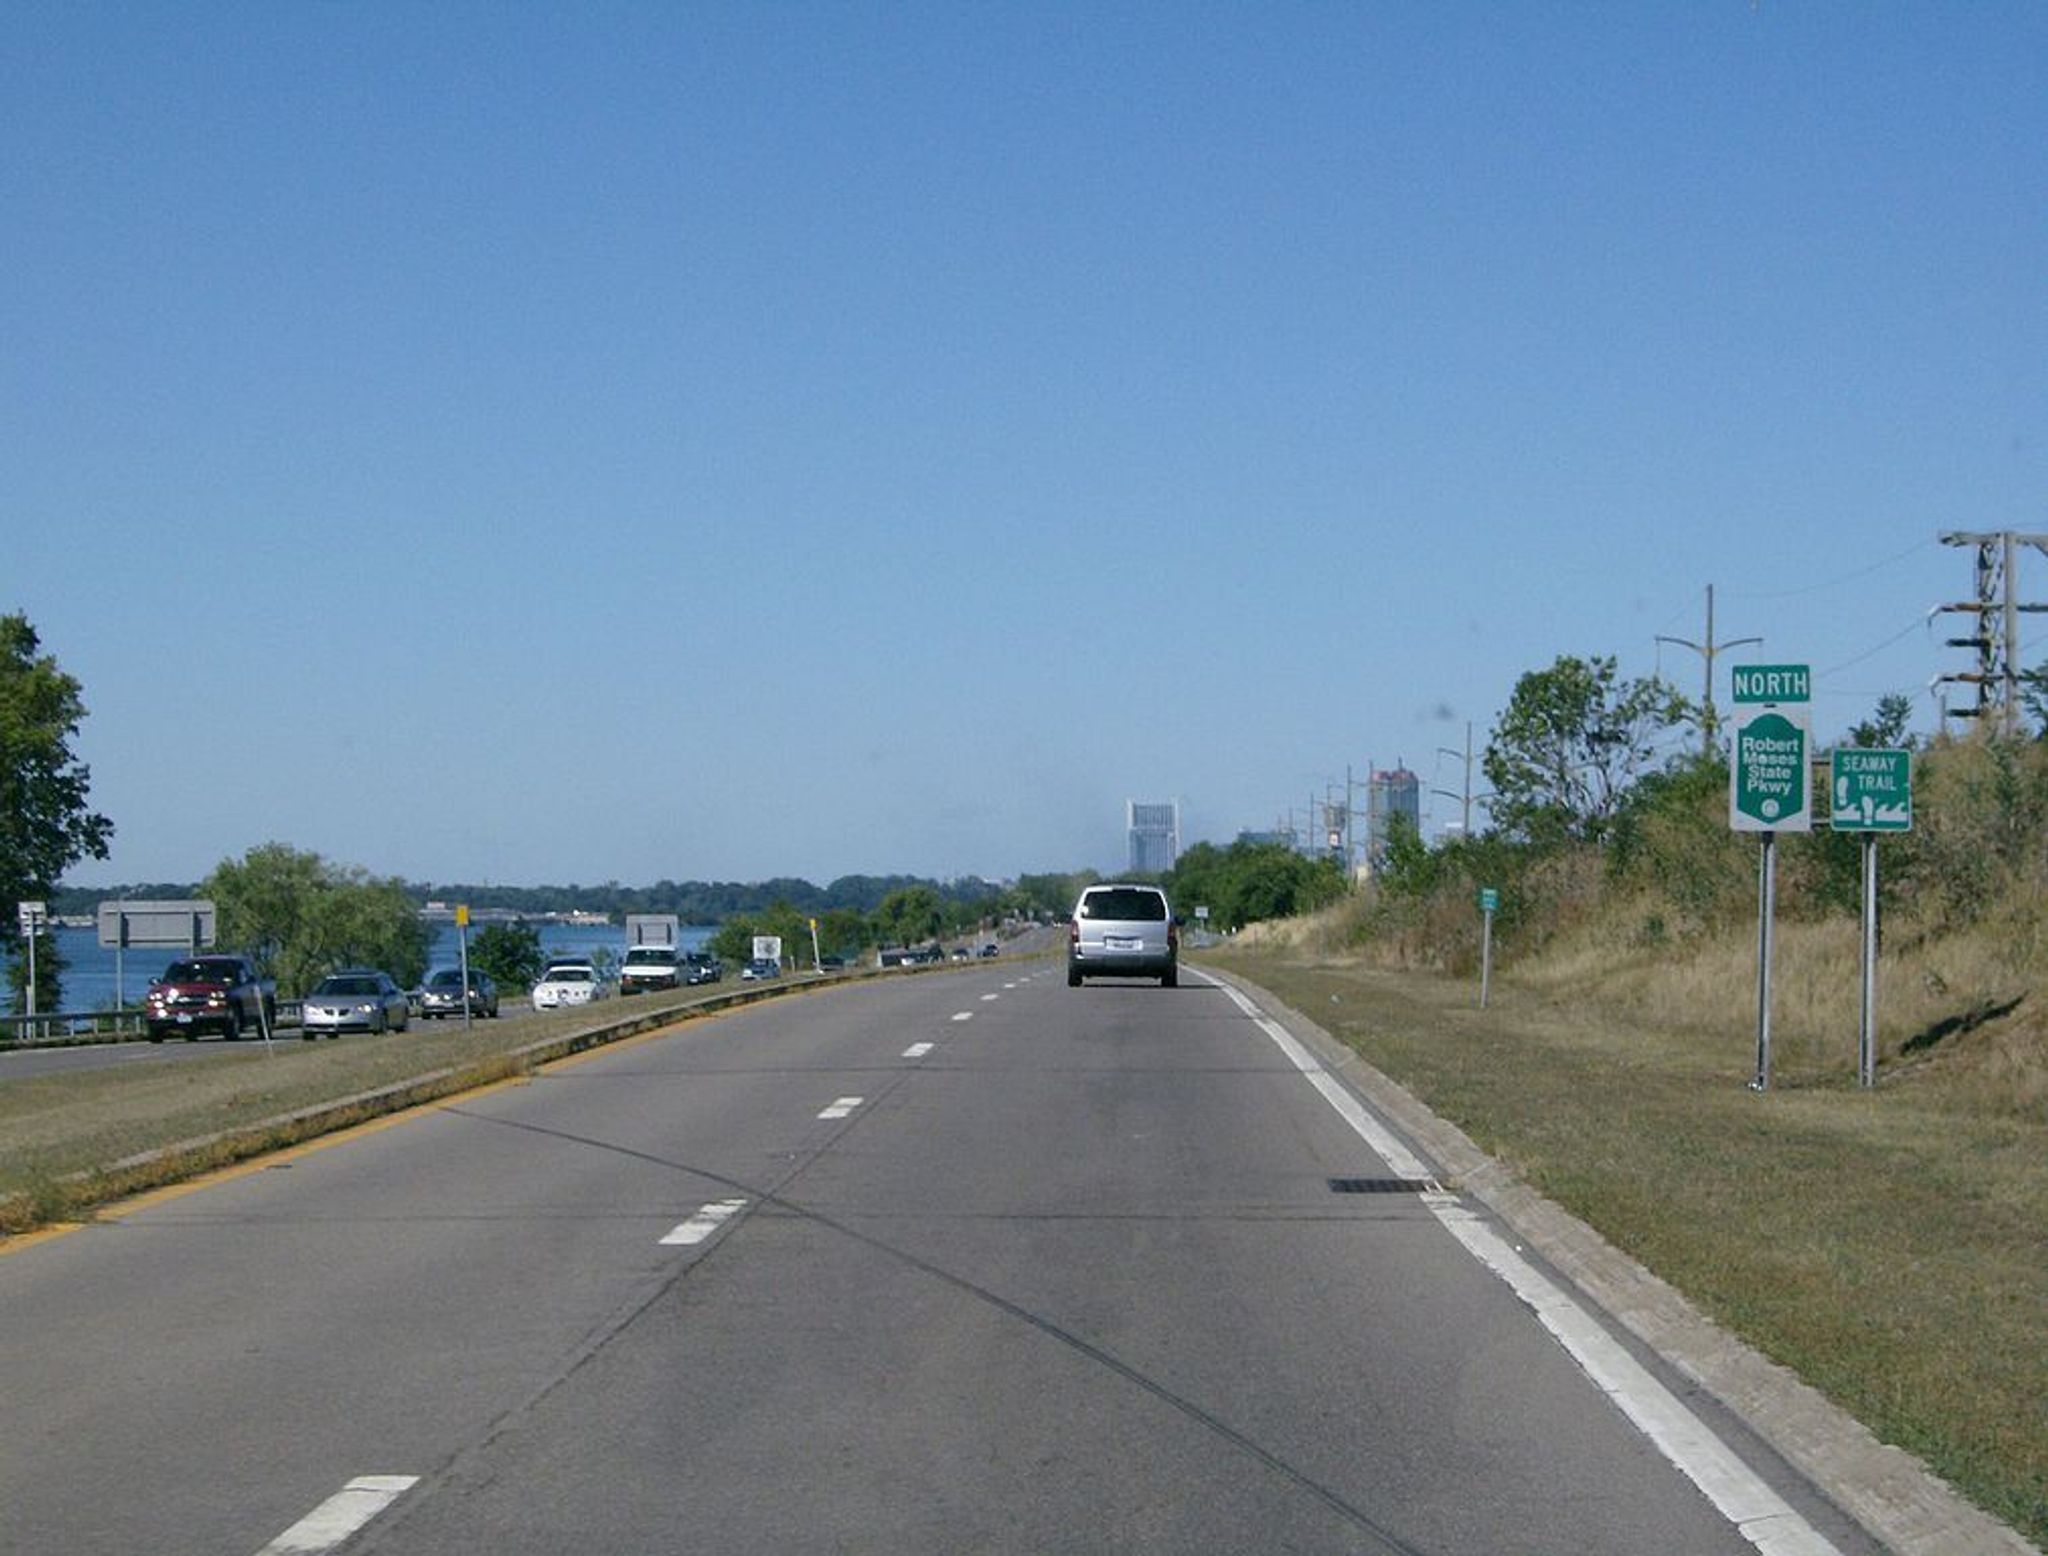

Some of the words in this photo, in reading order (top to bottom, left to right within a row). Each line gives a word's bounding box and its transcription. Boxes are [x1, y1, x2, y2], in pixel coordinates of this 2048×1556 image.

[1735, 672, 1807, 696] NORTH
[1742, 737, 1799, 752] Robert
[1743, 751, 1798, 765] Moses
[1842, 756, 1896, 771] SEAWAY
[1748, 765, 1792, 779] State
[1747, 779, 1792, 795] Pkwy
[1858, 774, 1897, 791] TRAIL
